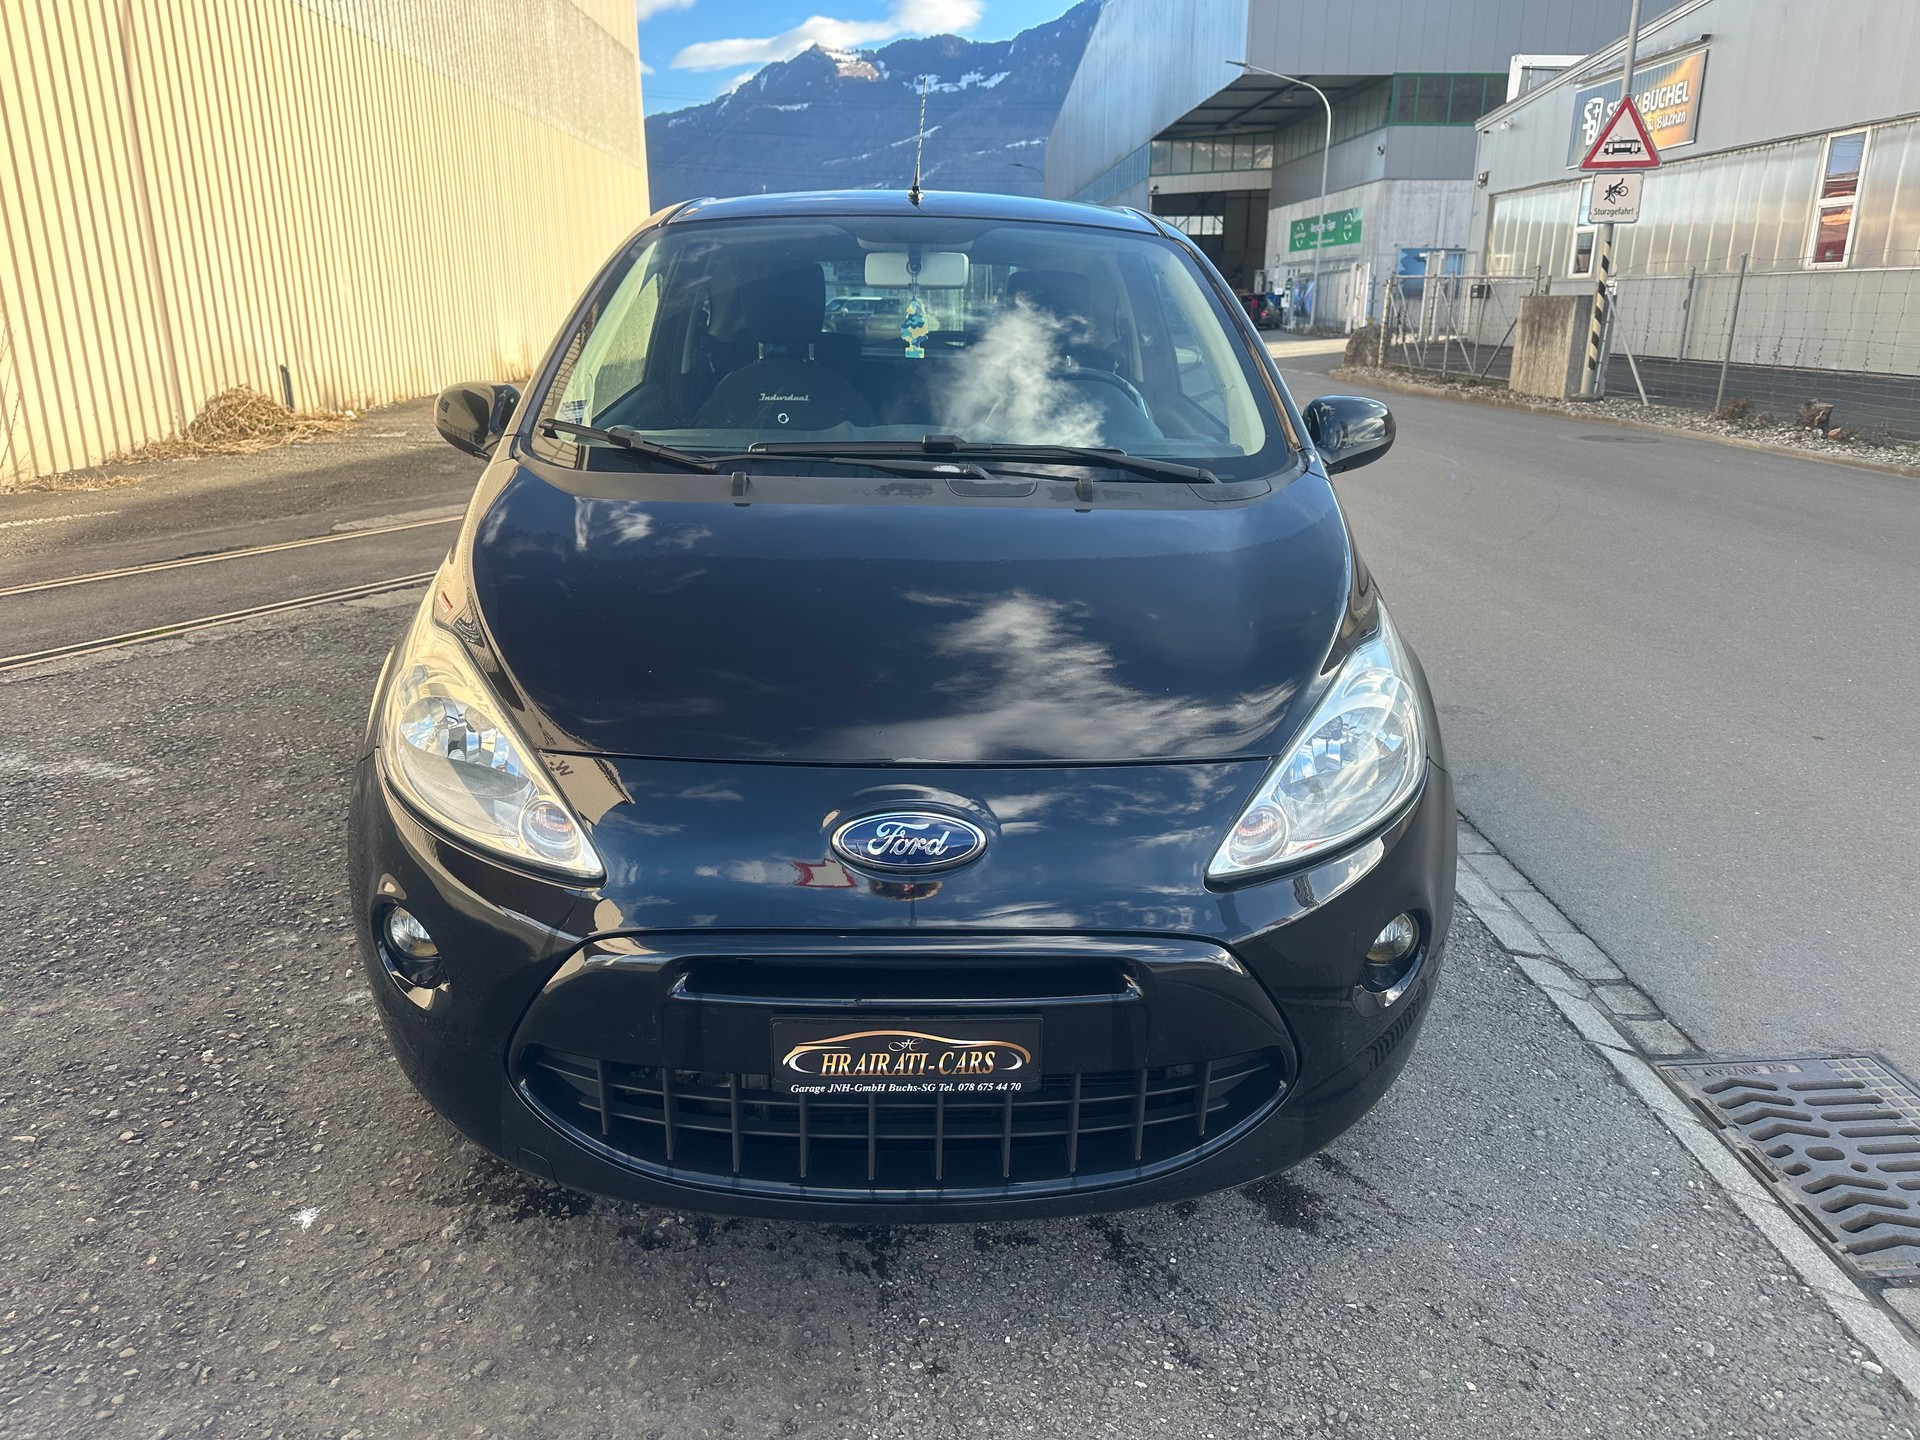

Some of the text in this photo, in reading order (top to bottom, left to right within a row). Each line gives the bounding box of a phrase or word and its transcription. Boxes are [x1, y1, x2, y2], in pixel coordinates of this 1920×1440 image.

[1593, 206, 1634, 217] Sturzgefahr!
[867, 821, 950, 856] Ford
[790, 1082, 1022, 1094] Garage JNH-GmbH Buchs-SG Tel. 078 675 44 70
